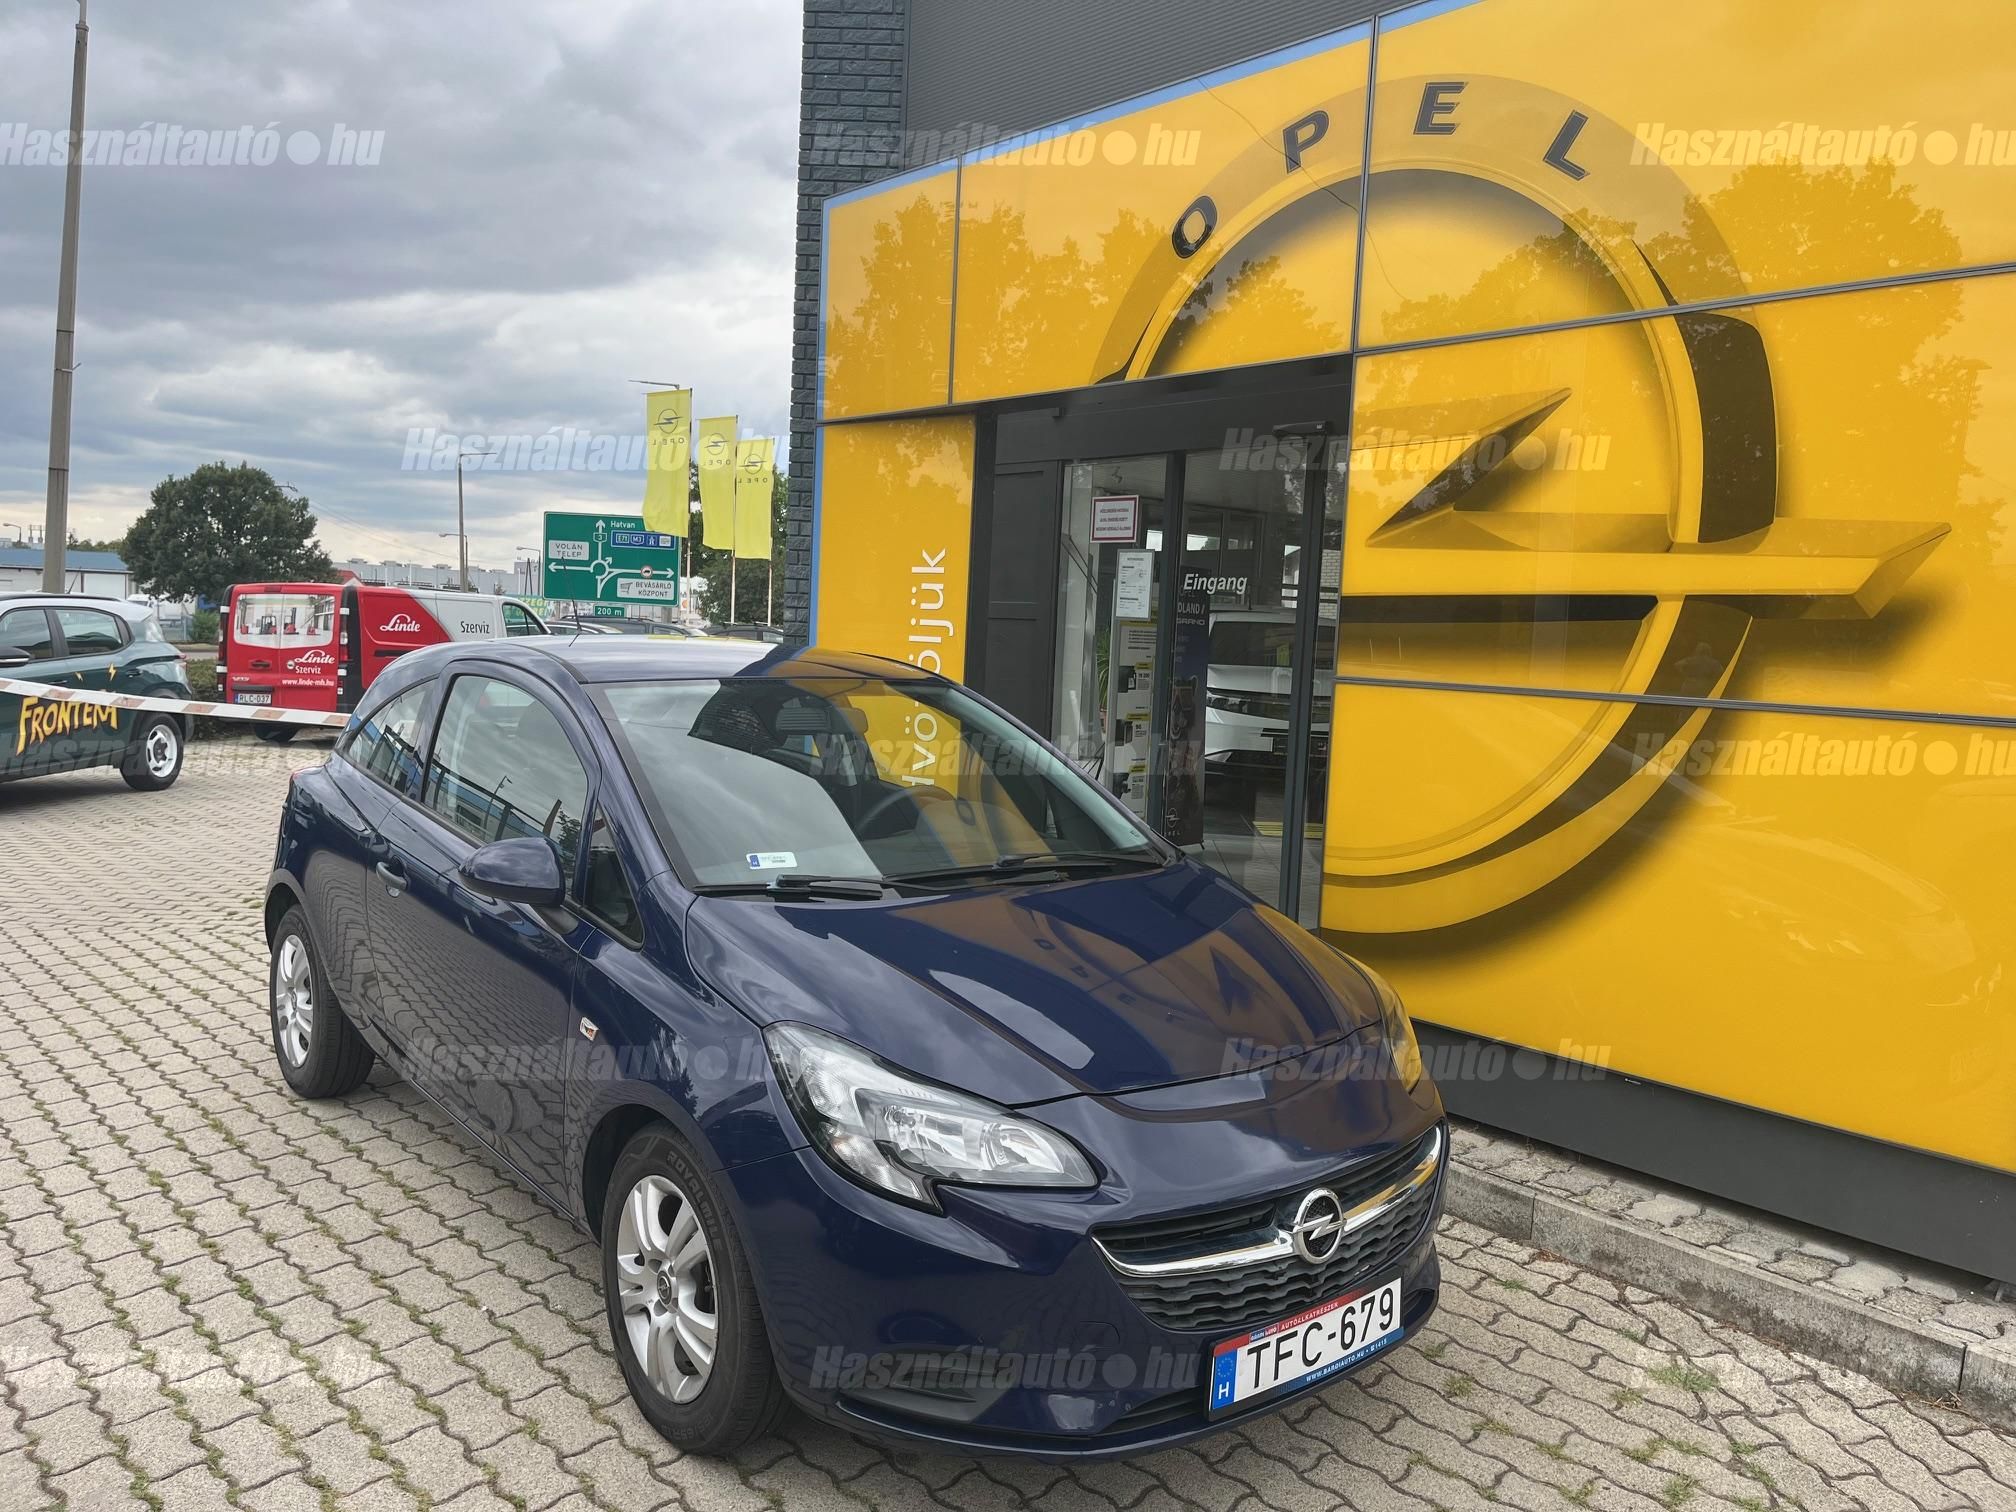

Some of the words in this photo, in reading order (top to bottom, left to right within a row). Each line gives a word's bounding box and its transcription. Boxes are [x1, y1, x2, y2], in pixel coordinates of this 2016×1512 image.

[1171, 80, 1592, 260] OPEL
[610, 520, 636, 529] Hatvan
[1183, 573, 1248, 594] Eingang
[597, 607, 612, 615] 200
[379, 613, 421, 632] Linde
[460, 620, 490, 634] Szerviz
[294, 649, 336, 664] Linde
[295, 665, 322, 674] Szerviz
[1247, 1287, 1394, 1389] TFC-679
[1218, 1380, 1229, 1400] H
